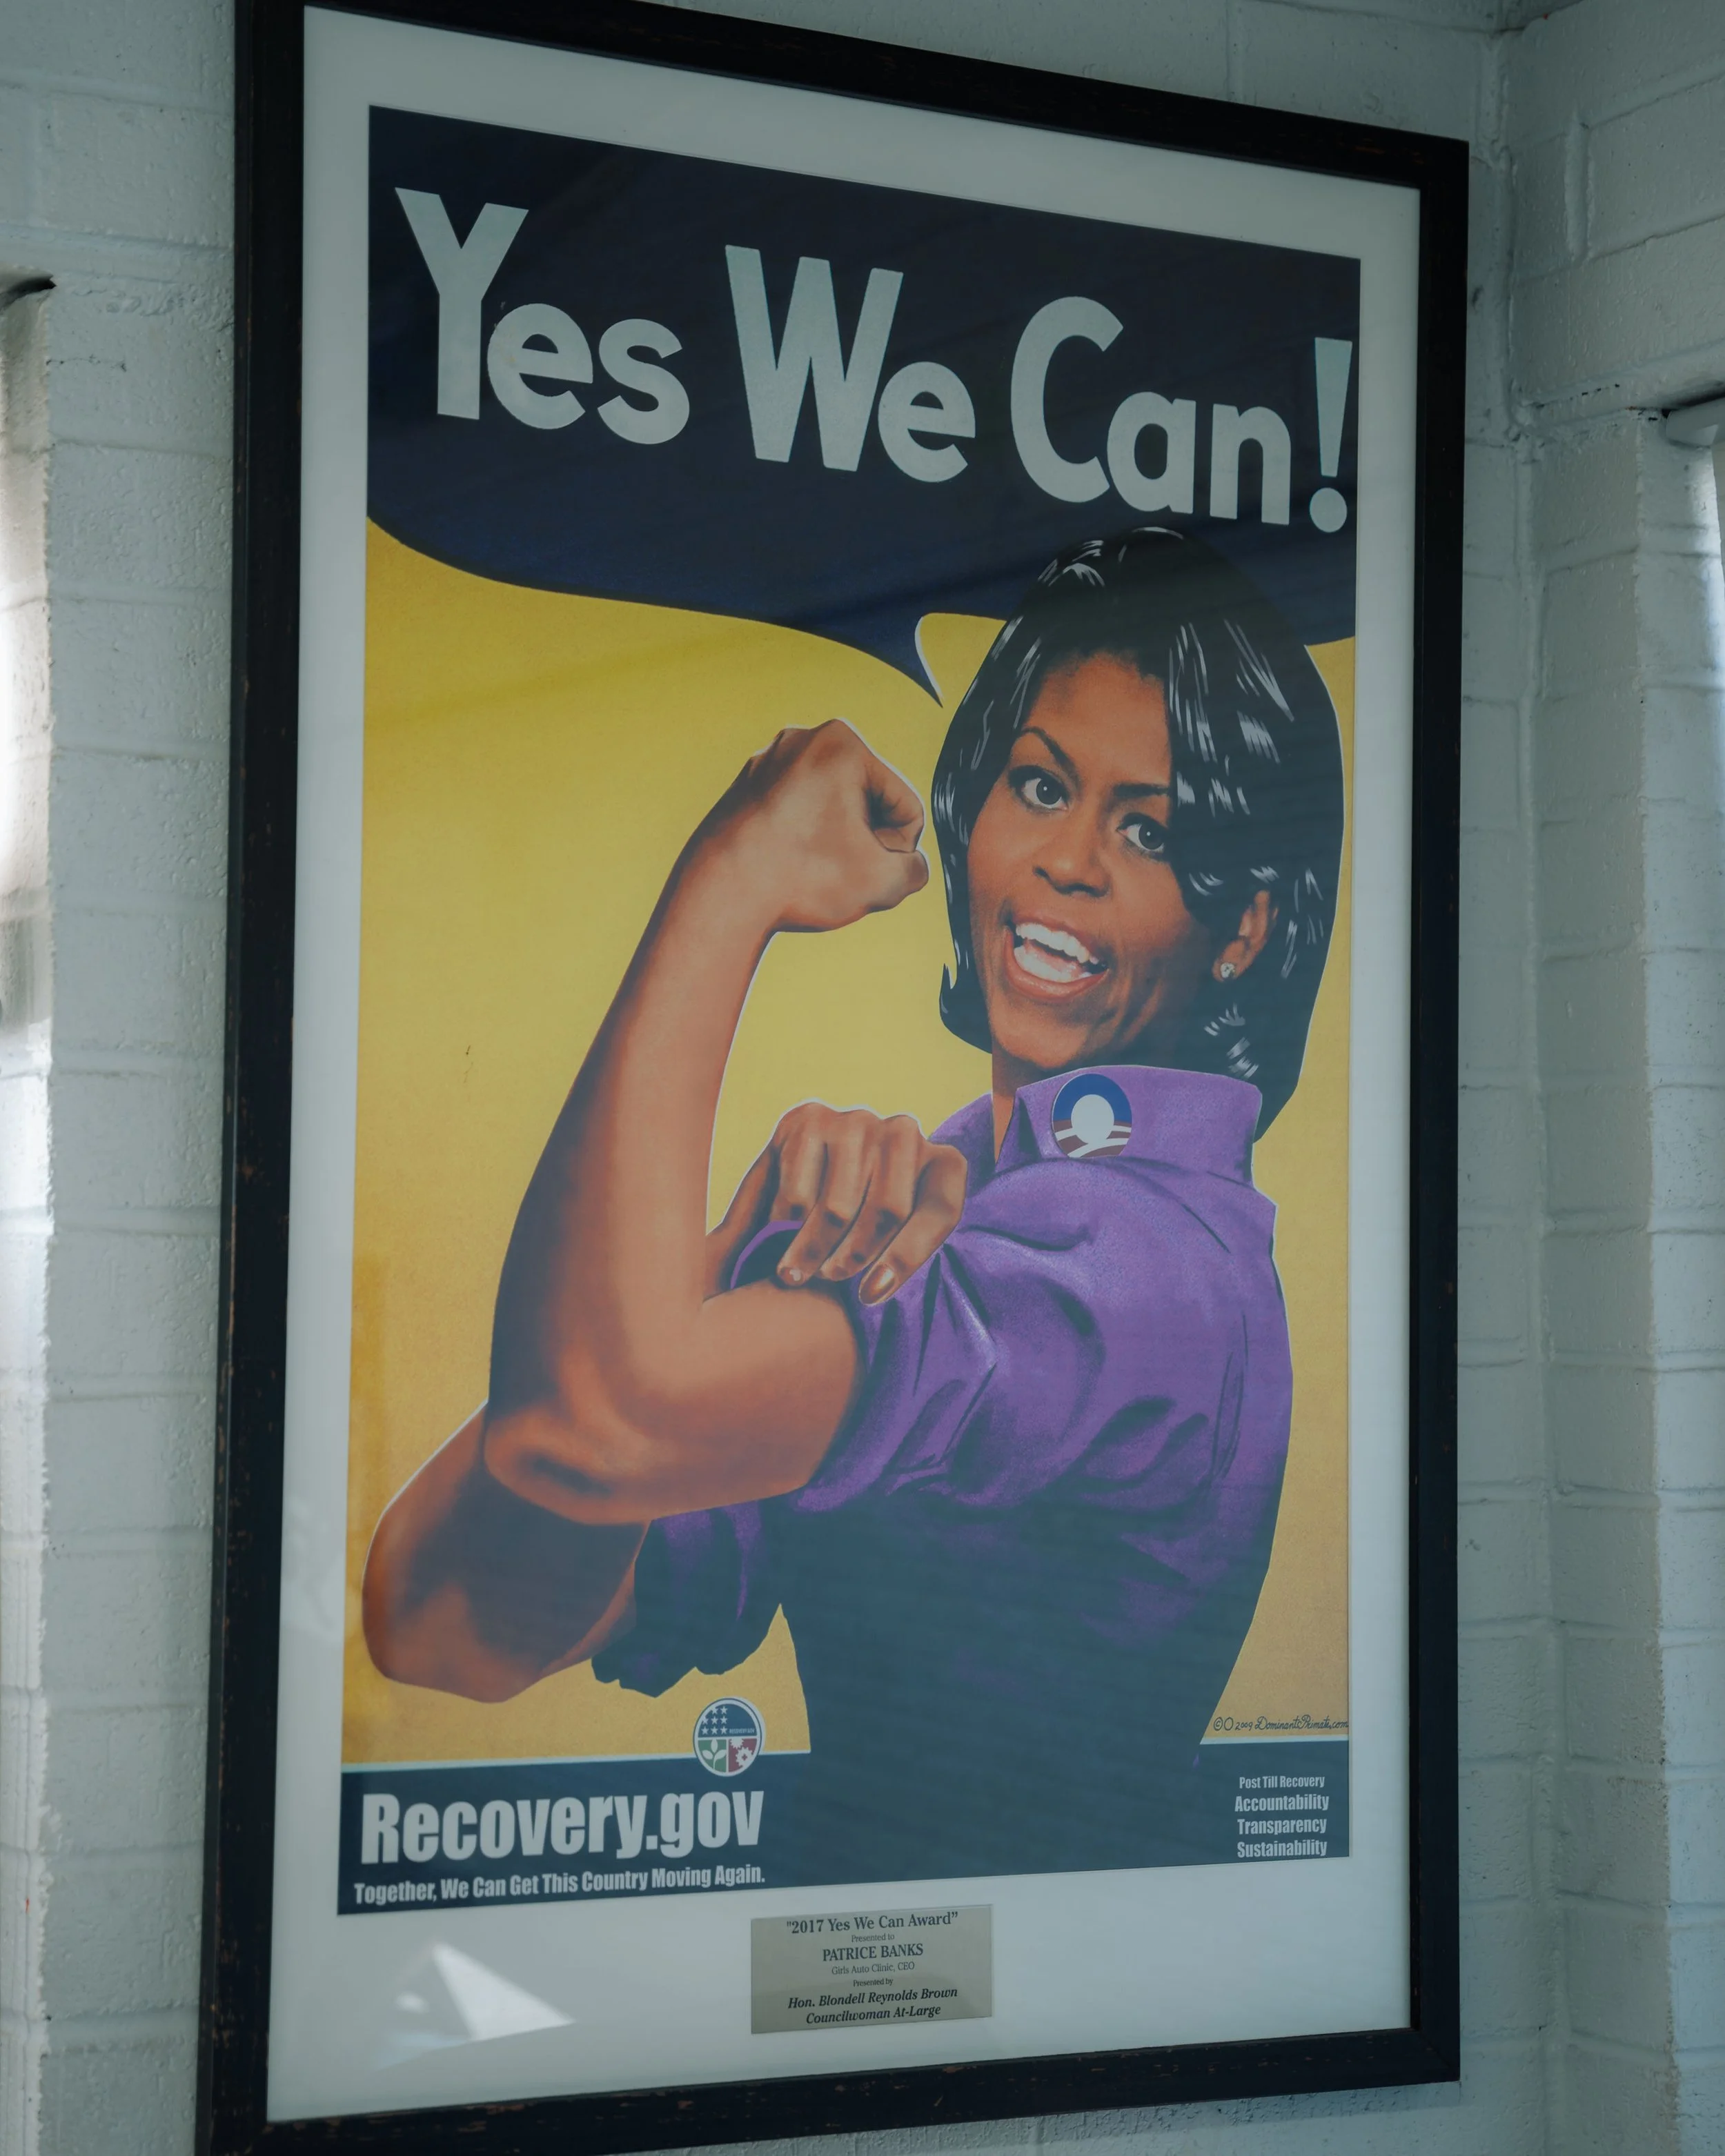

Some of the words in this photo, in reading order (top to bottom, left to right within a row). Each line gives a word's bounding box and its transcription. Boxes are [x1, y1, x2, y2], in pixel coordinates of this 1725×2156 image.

[395, 186, 691, 444] Yes
[724, 244, 976, 483] We
[1010, 295, 1353, 533] Can!
[1235, 1721, 1253, 1731] 2009
[1239, 1777, 1261, 1789] Post
[1262, 1776, 1278, 1788] Till
[1279, 1775, 1325, 1788] Recovery
[1234, 1794, 1330, 1812] Accountability
[361, 1790, 765, 1864] Recovery.gov
[1237, 1818, 1328, 1835] Transparency
[1237, 1839, 1328, 1858] Sustainability
[354, 1881, 437, 1906] Together,
[440, 1878, 469, 1899] We
[473, 1877, 506, 1897] Can
[510, 1875, 539, 1896] Get
[542, 1872, 578, 1894] This
[582, 1870, 649, 1892] Country
[651, 1866, 711, 1888] Moving
[714, 1864, 765, 1887] Again.
[827, 1918, 850, 1932] Yes
[854, 1916, 875, 1930] We
[878, 1915, 905, 1929] Can
[851, 1932, 887, 1943] Presented
[822, 1946, 877, 1961] PATRICE
[880, 1943, 924, 1958] BANKS
[831, 1966, 849, 1975] Girls
[851, 1965, 870, 1974] Auto
[871, 1963, 896, 1972] Clinic,
[898, 1961, 915, 1970] CEO
[853, 1979, 885, 1987] Presented
[885, 1977, 894, 1986] by
[788, 1997, 816, 2009] Hon.
[818, 1992, 865, 2006] Blondell
[867, 1989, 918, 2005] Reynolds
[920, 1988, 958, 1999] Brown
[806, 2009, 890, 2024] Councilwoman
[893, 2006, 941, 2018] At-Large
